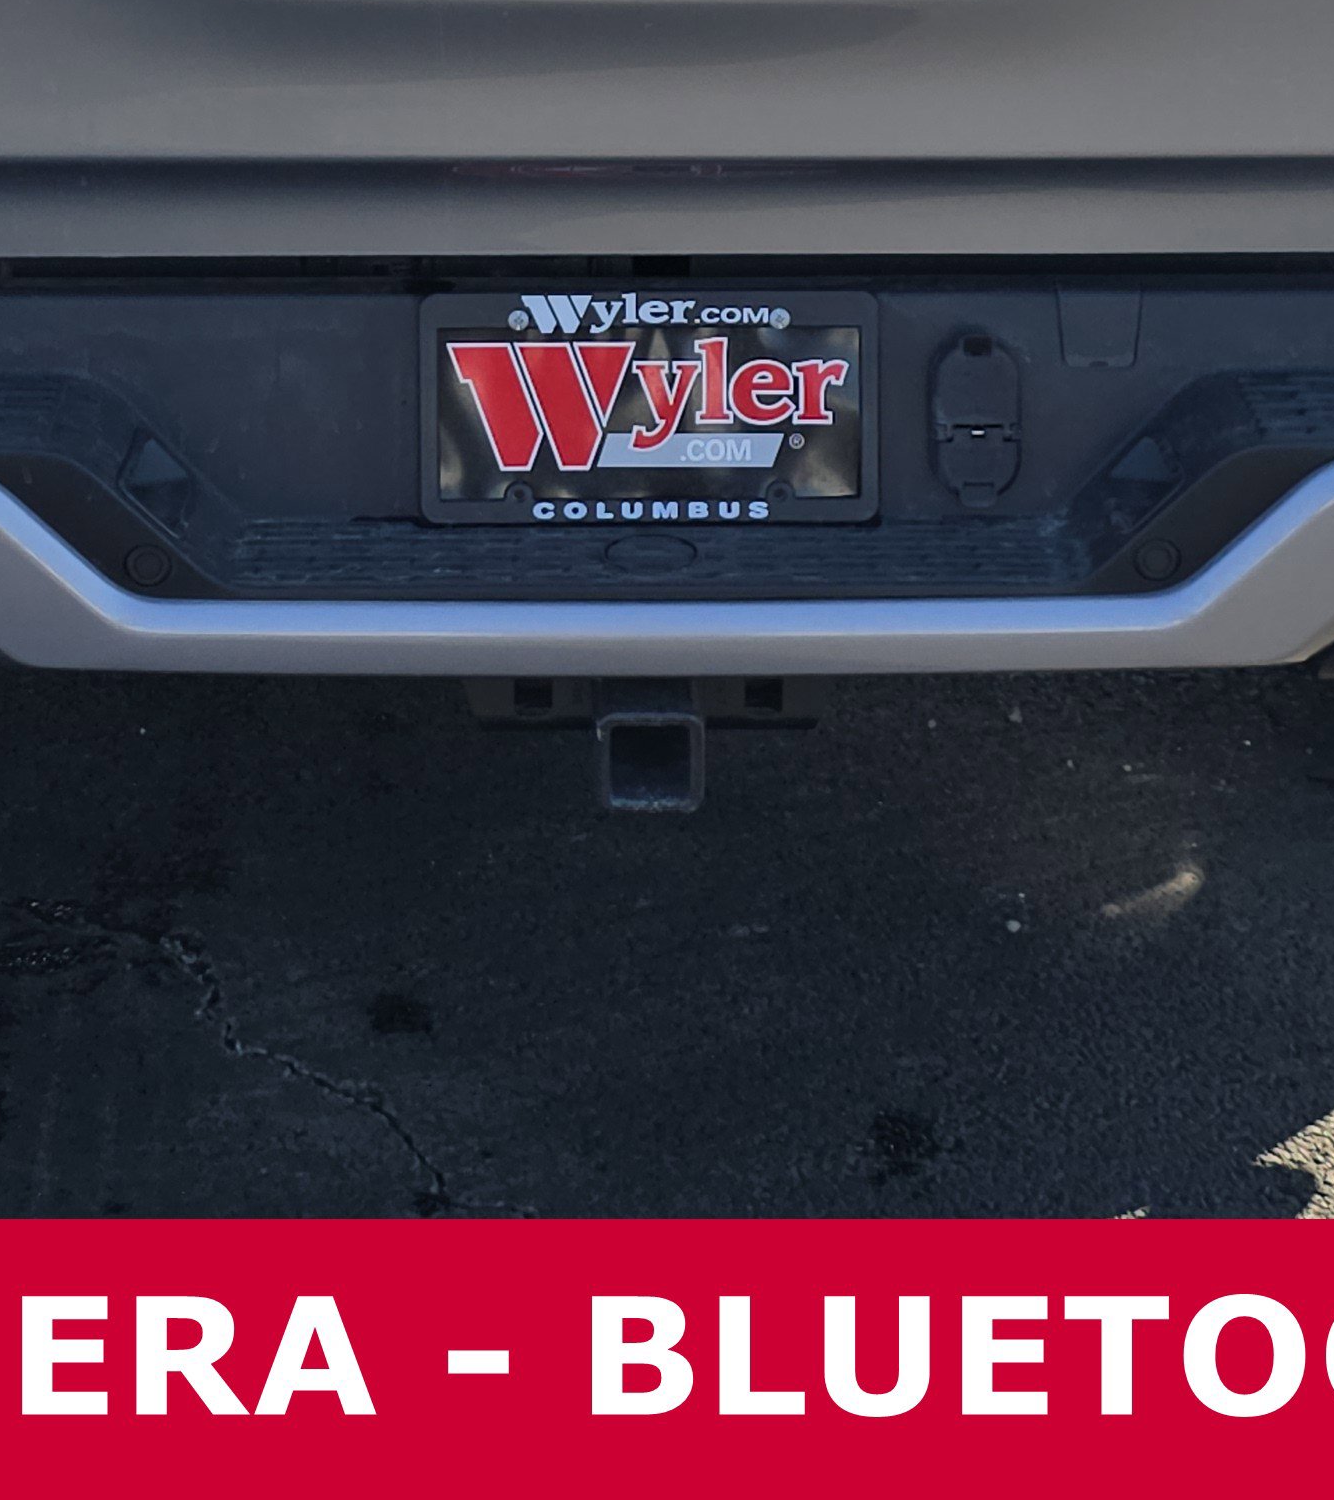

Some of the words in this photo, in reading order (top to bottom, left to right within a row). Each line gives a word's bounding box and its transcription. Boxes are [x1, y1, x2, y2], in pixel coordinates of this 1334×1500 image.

[446, 336, 850, 472] Wyler
[680, 438, 752, 462] .COM
[532, 501, 770, 520] COLUMBUS
